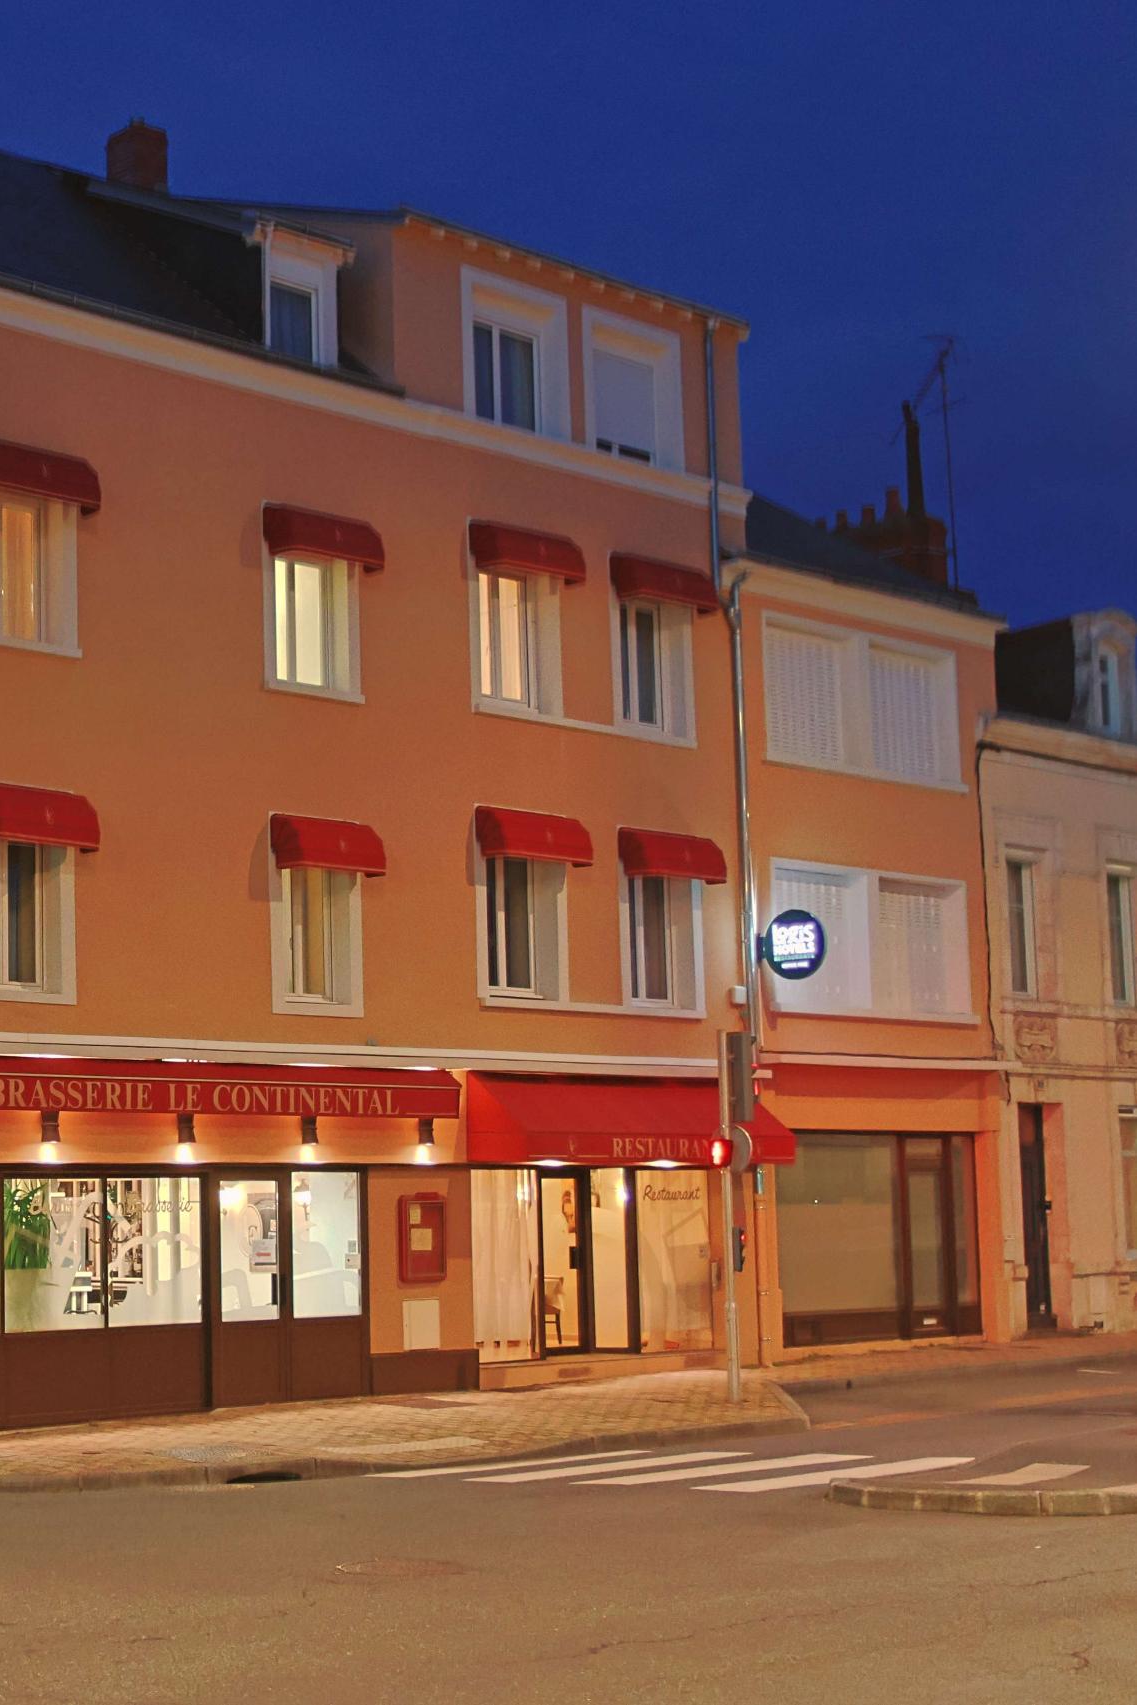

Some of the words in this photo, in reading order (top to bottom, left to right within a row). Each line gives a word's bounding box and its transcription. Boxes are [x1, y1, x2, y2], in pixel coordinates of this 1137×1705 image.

[167, 1083, 202, 1111] LE
[212, 1084, 400, 1116] CONTINENTAL
[612, 1137, 714, 1159] RESTAURAN
[642, 1184, 701, 1201] Restaurant
